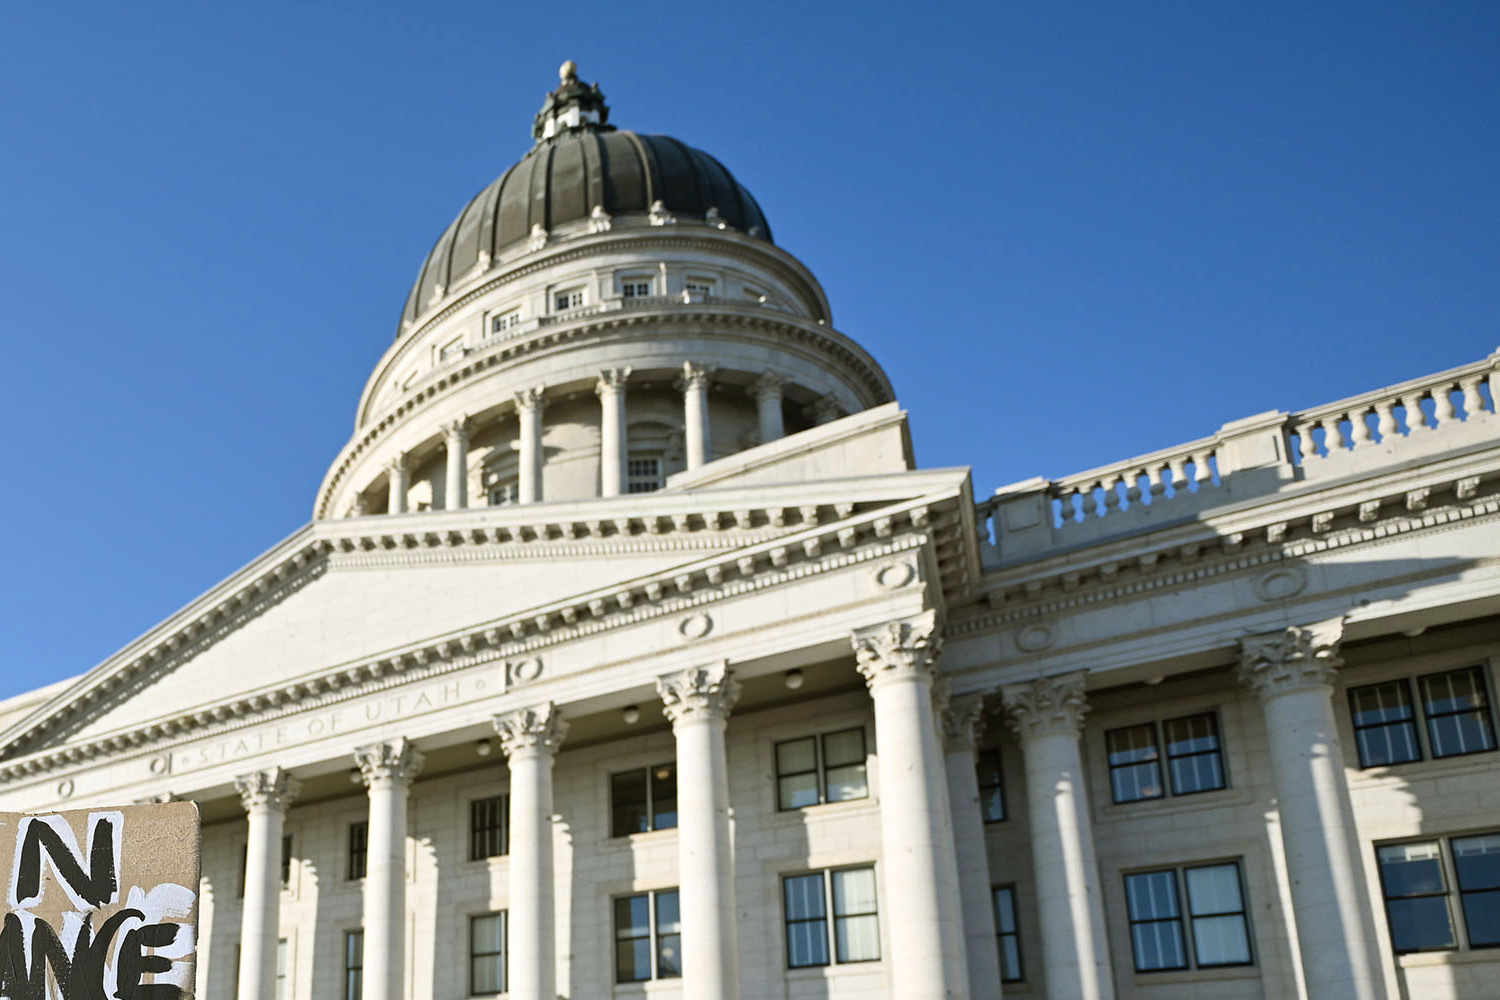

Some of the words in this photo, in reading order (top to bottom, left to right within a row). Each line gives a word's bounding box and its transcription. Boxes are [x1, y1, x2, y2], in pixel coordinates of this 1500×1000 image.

[199, 726, 290, 765] STATE
[307, 714, 342, 737] OF
[365, 680, 461, 722] UTAH
